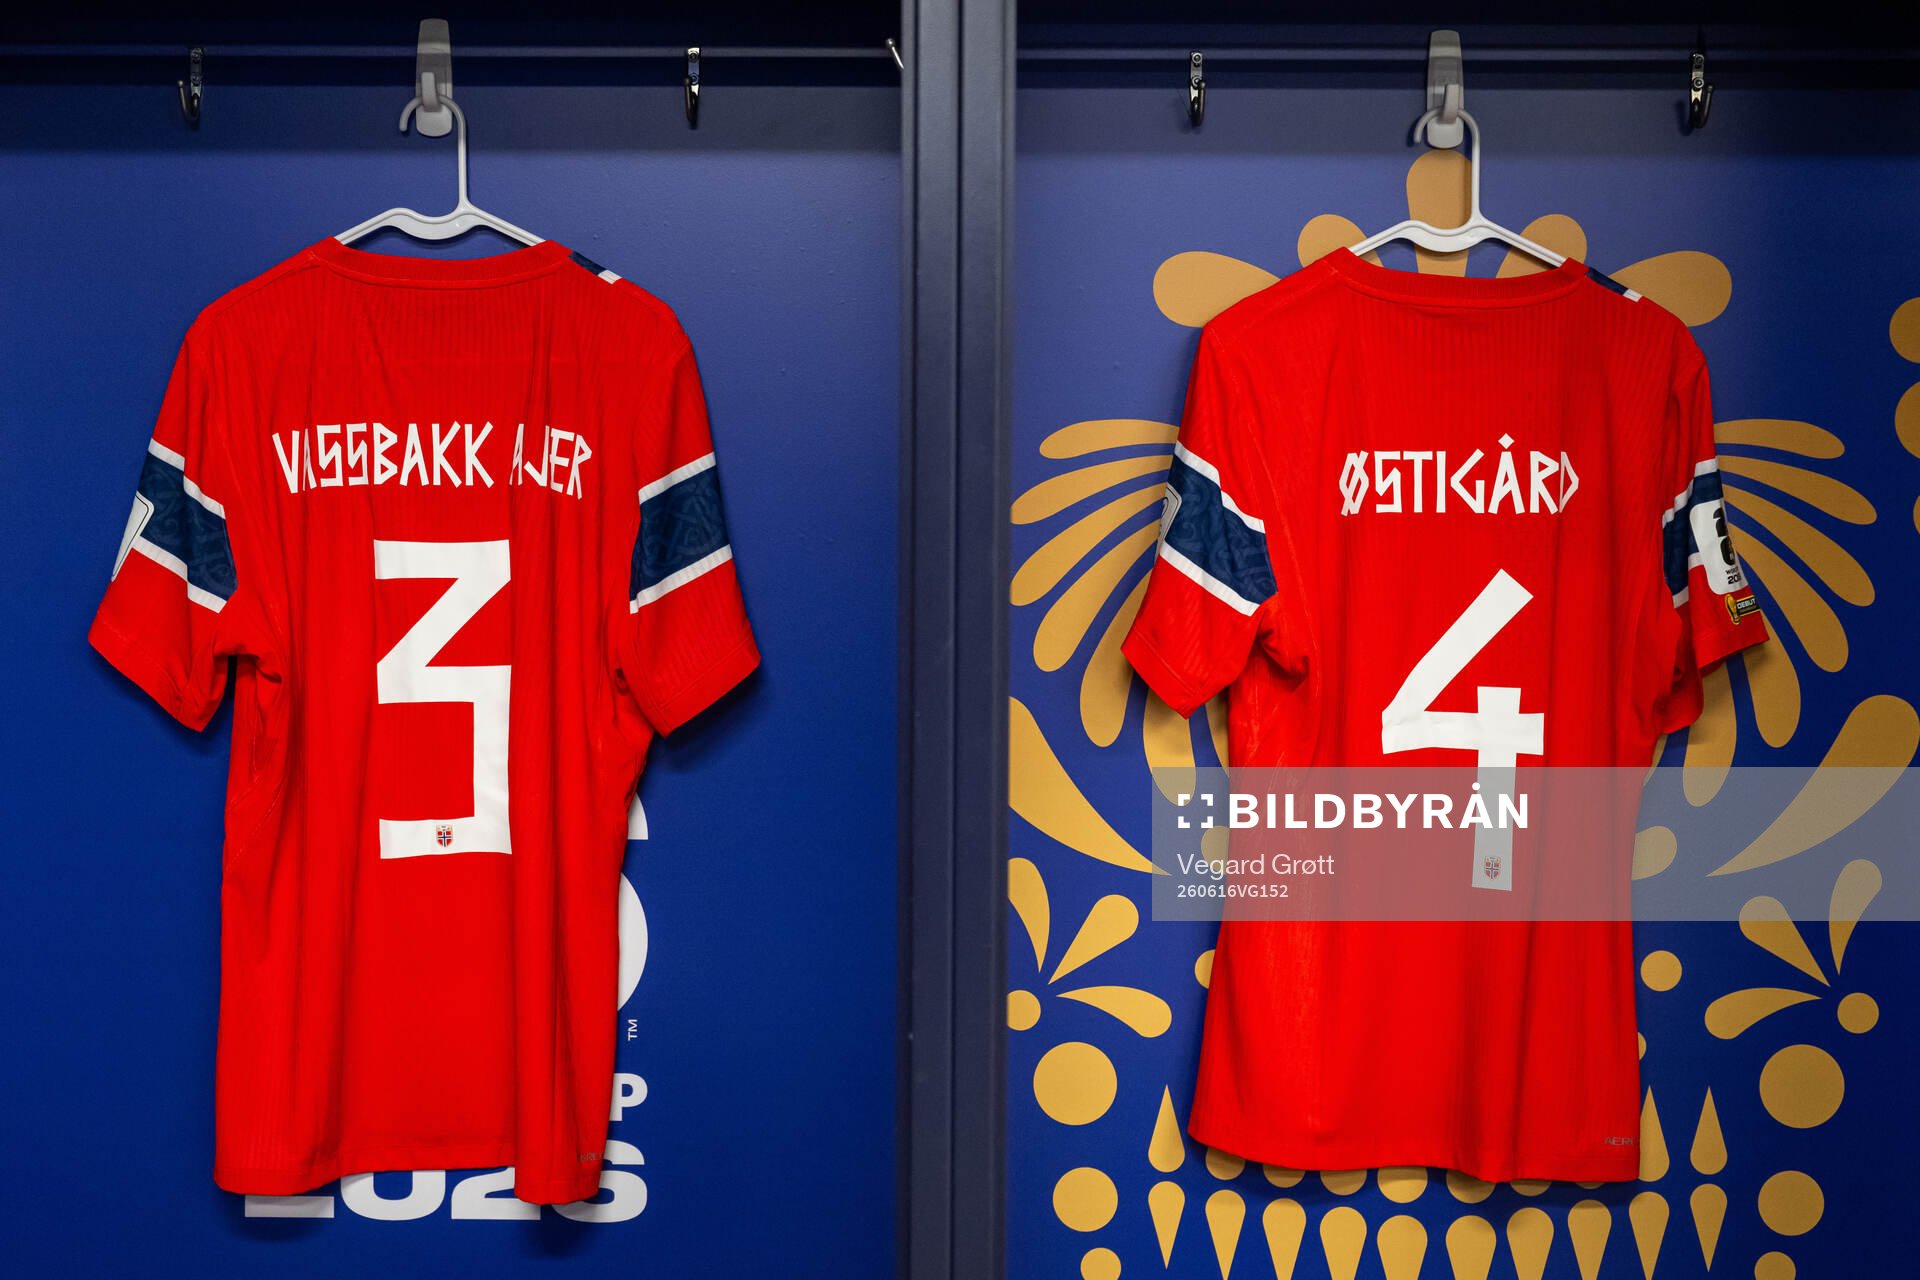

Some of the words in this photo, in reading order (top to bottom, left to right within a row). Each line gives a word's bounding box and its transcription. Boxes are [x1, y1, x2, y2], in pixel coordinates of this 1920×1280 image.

[271, 420, 495, 495] VASSBAKK
[510, 423, 593, 500] AJER
[1338, 433, 1580, 517] ØSTIGÅRD
[373, 539, 513, 860] 3
[1381, 568, 1545, 891] 4
